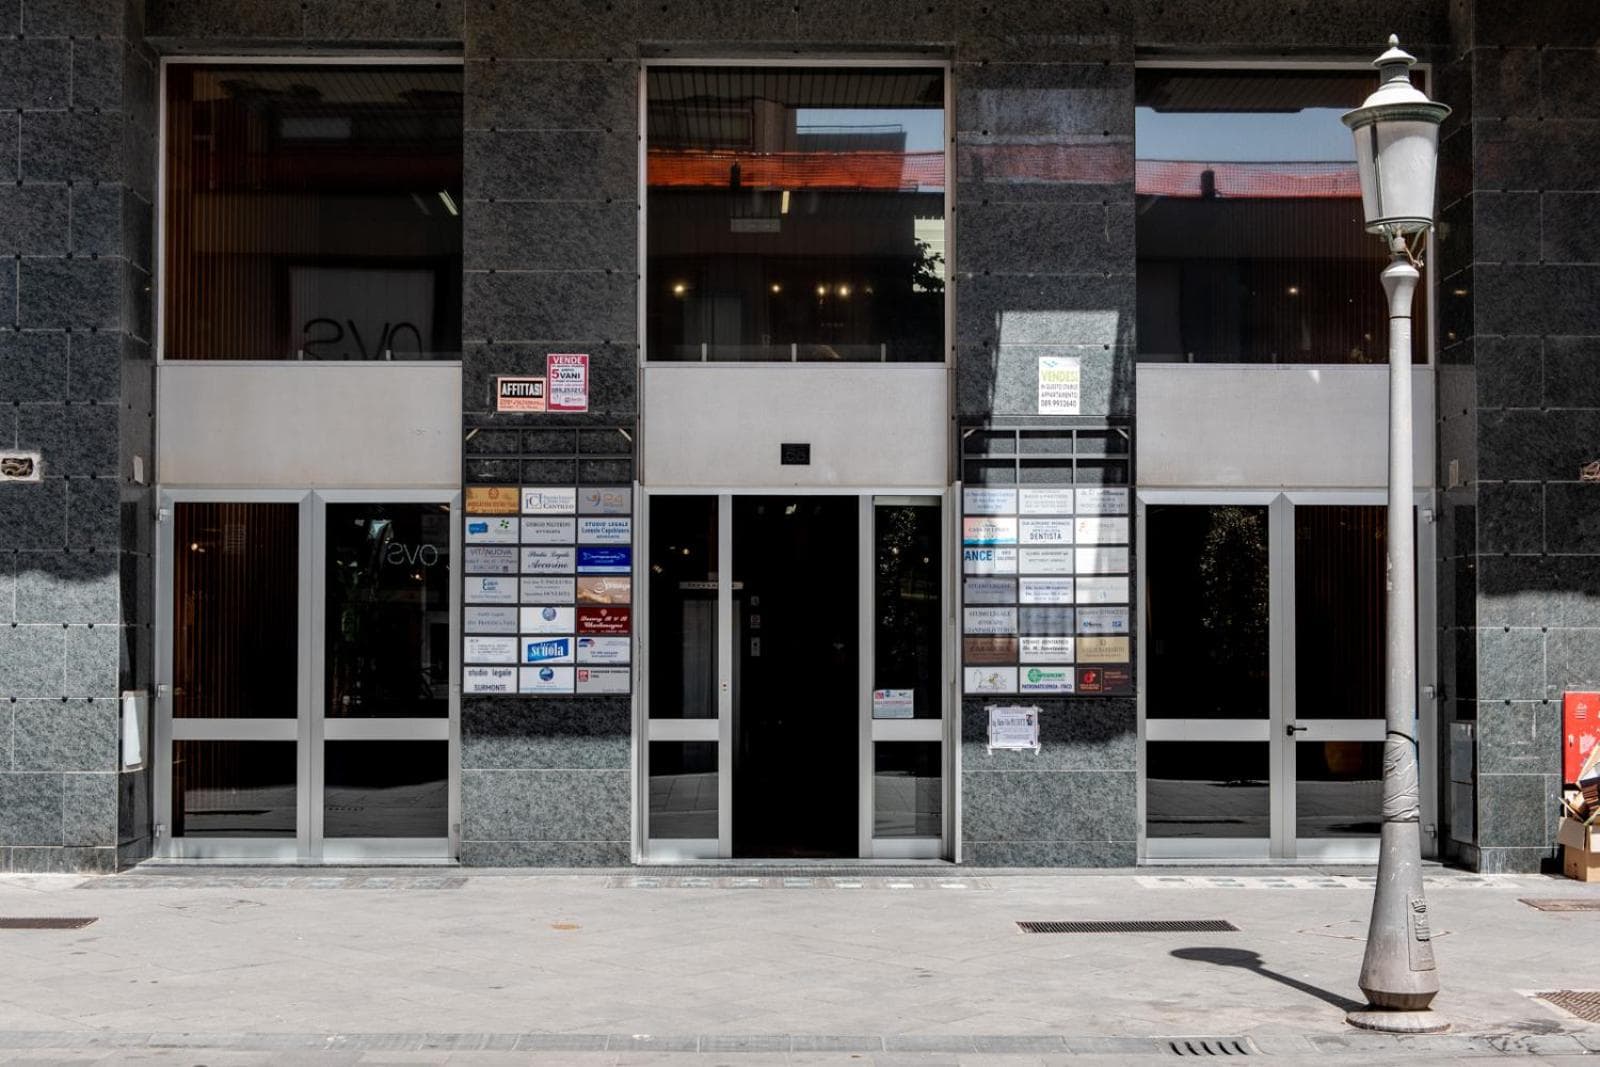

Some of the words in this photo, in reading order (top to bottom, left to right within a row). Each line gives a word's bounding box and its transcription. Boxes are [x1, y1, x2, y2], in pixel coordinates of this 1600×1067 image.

[553, 356, 582, 364] VENDE
[551, 369, 560, 379] 5
[1041, 370, 1079, 382] VENDESI
[501, 383, 542, 396] AFFITTASI
[1030, 532, 1062, 540] DENTISTA
[964, 550, 993, 561] ANCE
[468, 668, 489, 676] studio
[492, 668, 512, 678] legale
